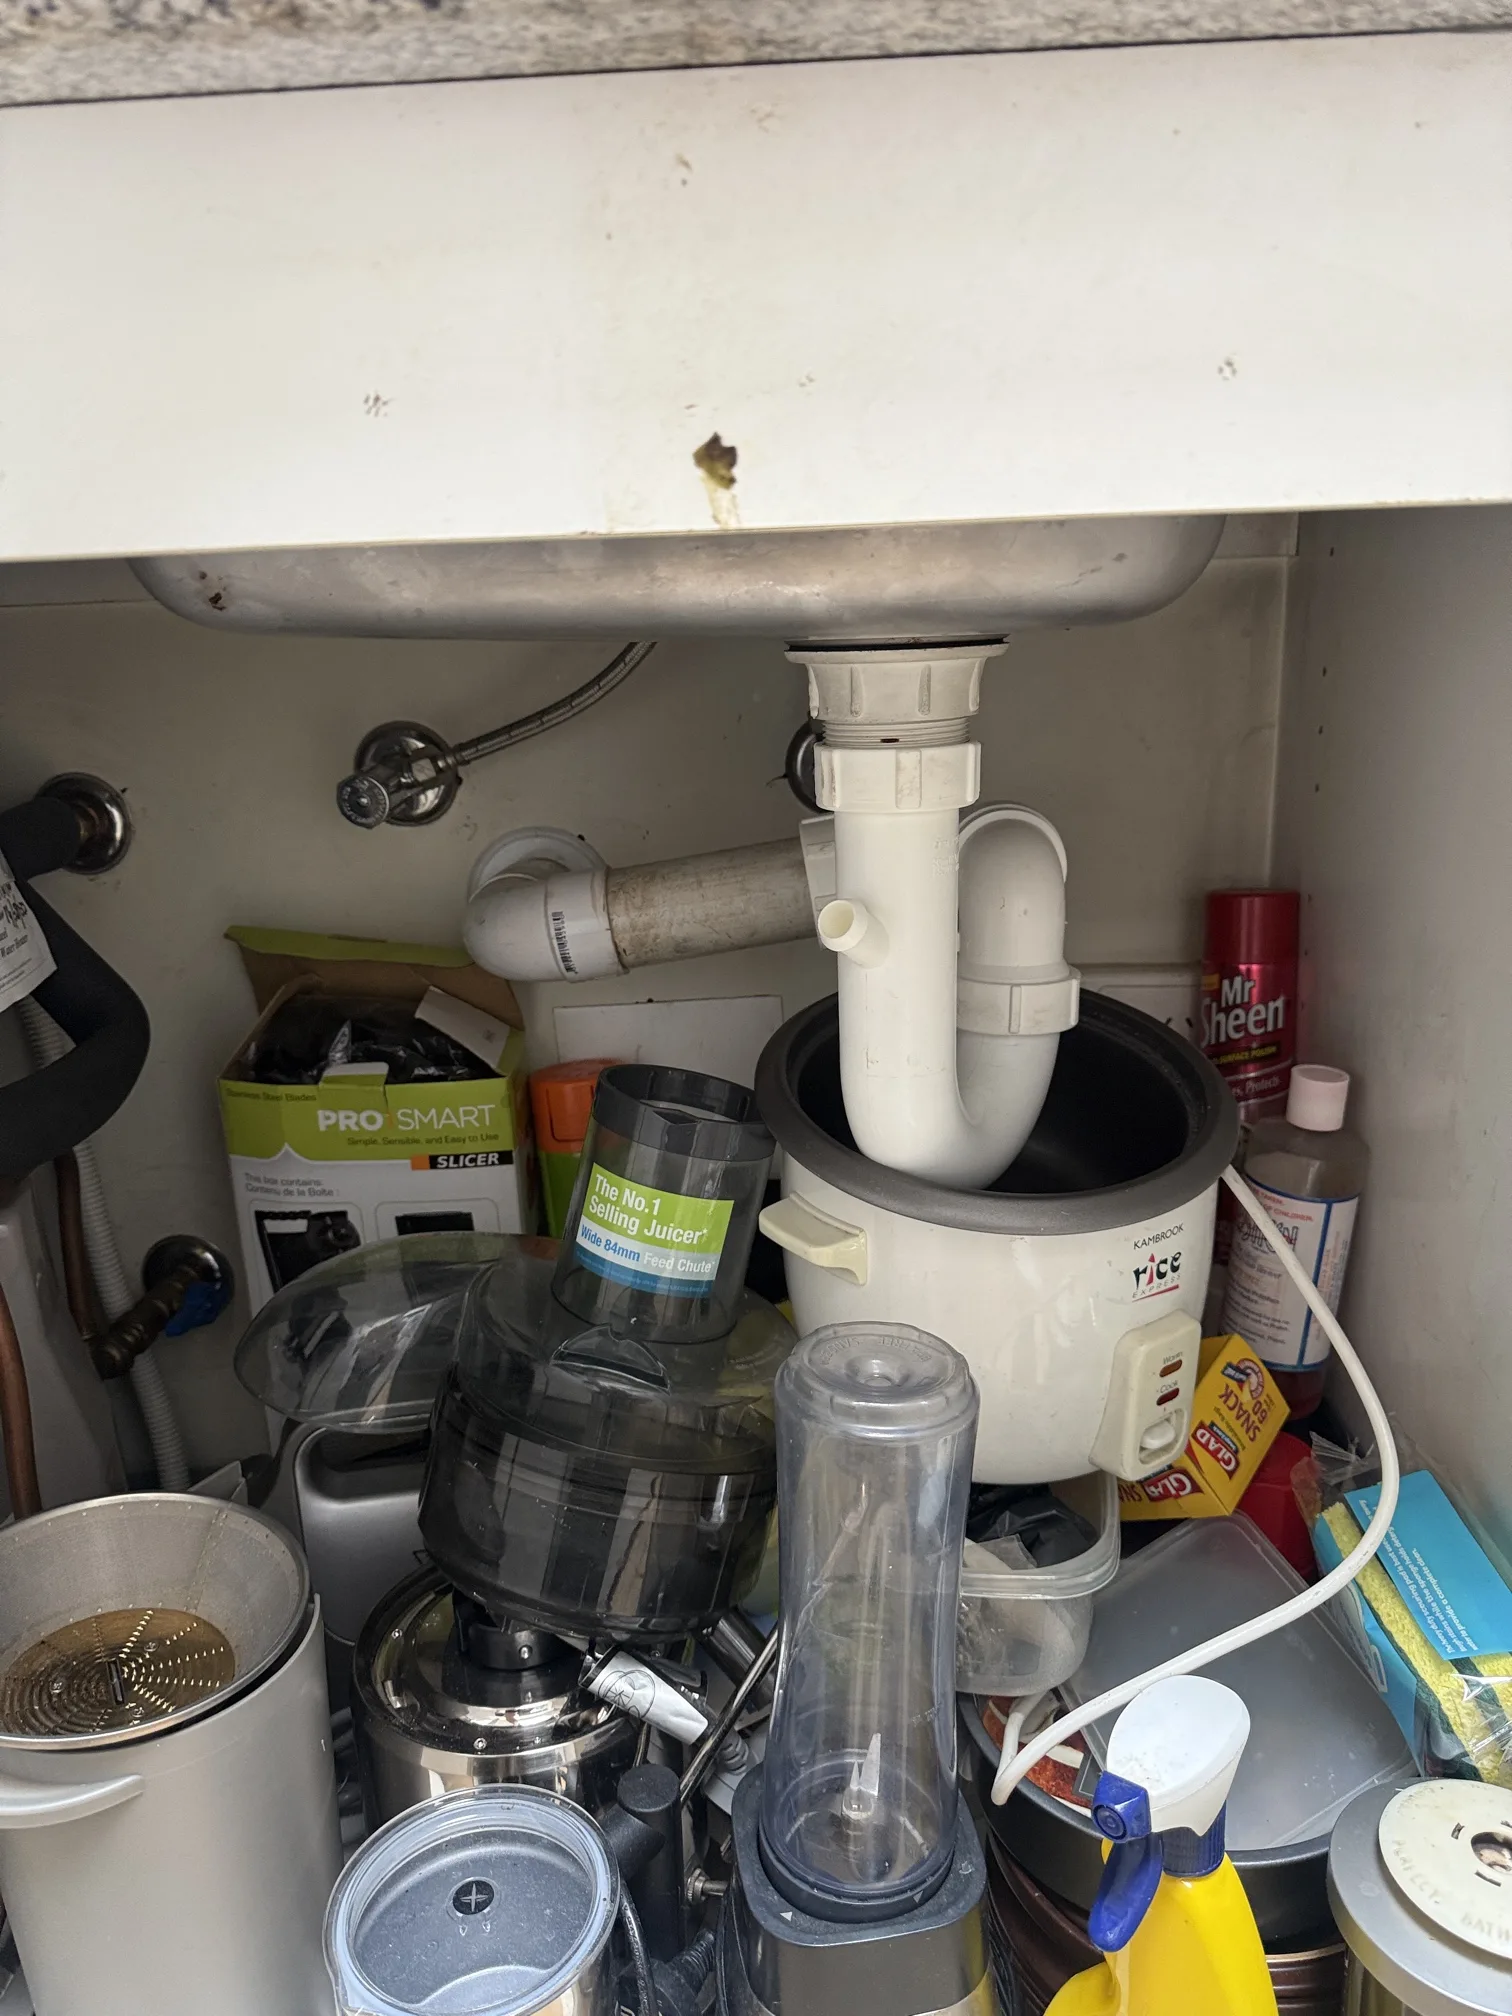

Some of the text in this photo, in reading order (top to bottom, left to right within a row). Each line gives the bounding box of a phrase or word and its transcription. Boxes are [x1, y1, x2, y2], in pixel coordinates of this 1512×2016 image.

[1221, 975, 1255, 1008] Mr
[1200, 996, 1284, 1049] Sheen
[317, 1104, 495, 1131] PRO SMART
[425, 1135, 442, 1144] and
[445, 1134, 465, 1145] Easy
[468, 1134, 478, 1142] to
[480, 1133, 499, 1142] Use
[437, 1153, 499, 1168] SLICER
[245, 1172, 262, 1183] This
[263, 1175, 278, 1185] box
[283, 1187, 295, 1196] de
[297, 1187, 306, 1196] la
[595, 1174, 661, 1216] The No.1
[589, 1195, 640, 1235] Selling
[581, 1224, 602, 1247] Wide
[604, 1238, 640, 1262] 84mm
[643, 1252, 675, 1270] Feed
[1133, 1223, 1184, 1250] KAMBROOK
[1132, 1251, 1182, 1291] rice
[1132, 1273, 1181, 1298] EXPRESS
[1163, 1351, 1183, 1364] Warm
[1160, 1380, 1178, 1394] Cook
[1219, 1383, 1261, 1443] SNACK
[1251, 1400, 1268, 1425] 60
[1195, 1428, 1237, 1472] GLAD
[1390, 1528, 1402, 1548] deterg
[1388, 1552, 1401, 1566] best
[1398, 1547, 1411, 1565] holds
[1399, 1571, 1414, 1585] pad
[1409, 1564, 1426, 1588] sponge
[1422, 1566, 1445, 1599] complete
[1409, 1584, 1429, 1616] scouring
[1423, 1588, 1434, 1603] the
[1426, 1616, 1438, 1630] duty
[1431, 1602, 1445, 1621] while
[1446, 1605, 1465, 1631] provide
[1434, 1630, 1448, 1645] heavy
[1442, 1621, 1456, 1638] stains
